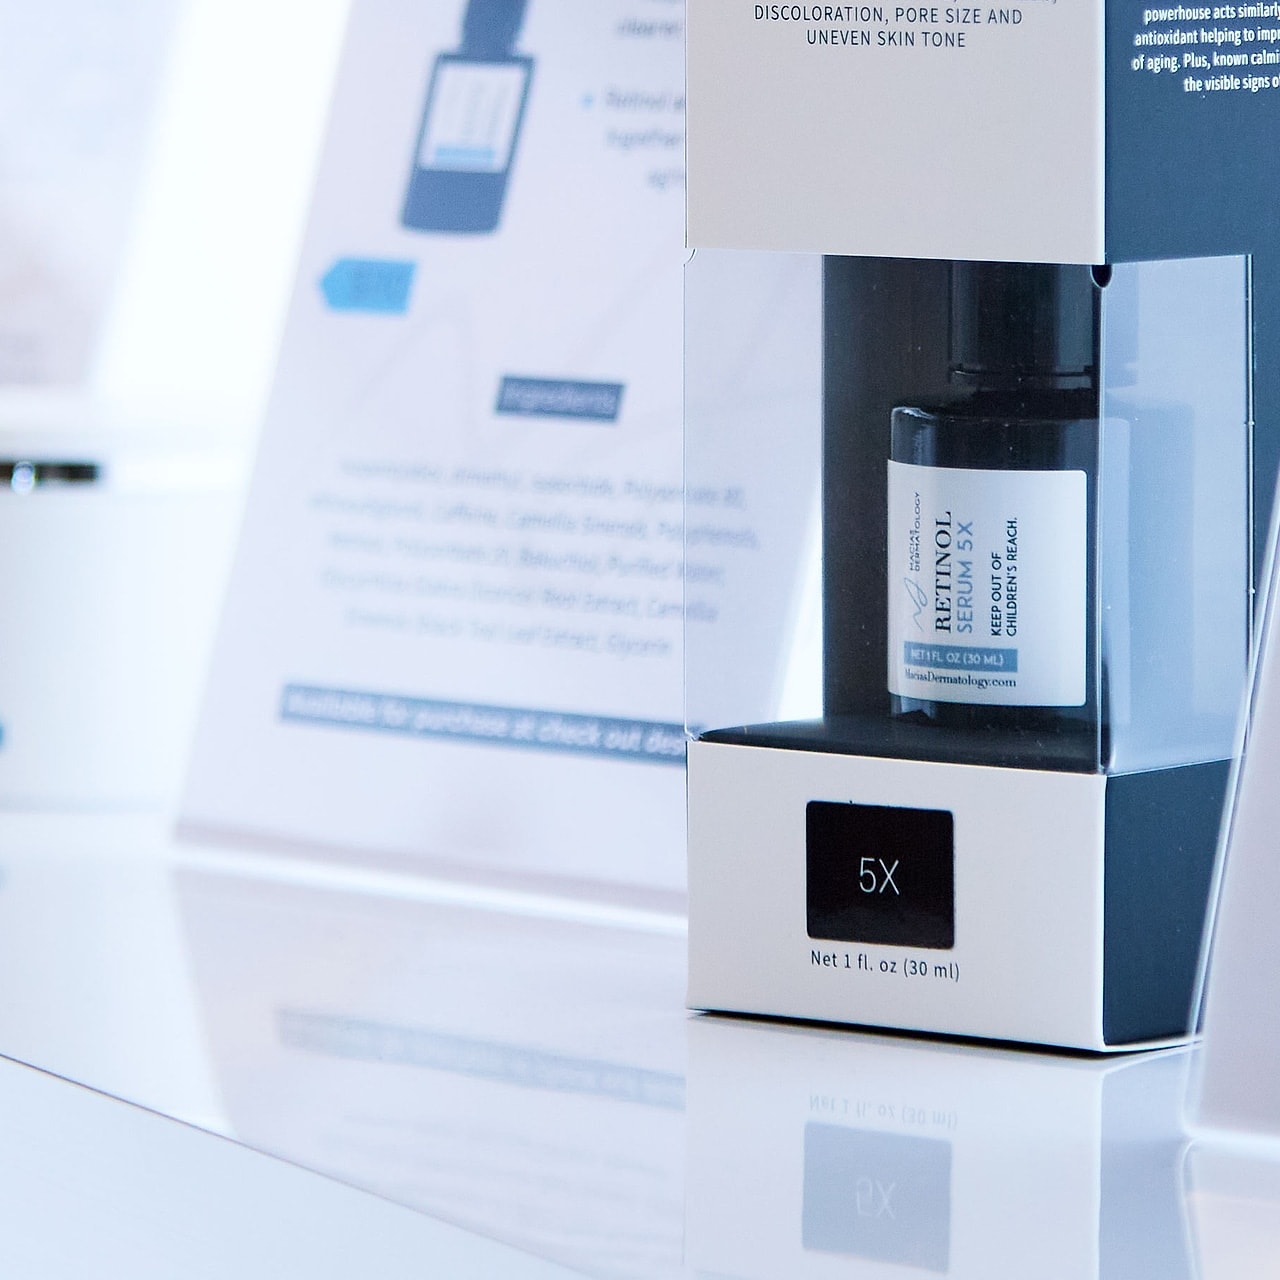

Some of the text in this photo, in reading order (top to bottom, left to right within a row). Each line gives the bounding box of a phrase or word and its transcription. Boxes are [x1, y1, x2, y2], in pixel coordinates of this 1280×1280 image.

[754, 5, 1023, 25] DISCOLORATION, PORE SIZE AND
[1144, 6, 1211, 25] powerhouse
[1213, 5, 1236, 19] acts
[807, 30, 966, 48] UNEVEN SKIN TONE
[1135, 29, 1198, 46] antioxidant
[1201, 28, 1241, 46] helping
[1243, 28, 1255, 42] to
[1133, 54, 1145, 70] of
[1148, 56, 1181, 73] aging.
[1184, 53, 1211, 70] Plus,
[1213, 51, 1248, 66] known
[1184, 77, 1202, 92] the
[1205, 75, 1240, 91] visible
[1242, 74, 1269, 92] signs
[935, 511, 952, 634] RETINOL
[957, 521, 973, 634] SERUM 5X
[1006, 517, 1018, 637] CHILDREN'S REACH.
[991, 552, 1002, 637] KEEP OUT OF
[946, 652, 960, 664] OZ
[963, 653, 980, 665] (30
[984, 654, 1004, 667] ML)
[859, 856, 900, 895] 5X
[811, 950, 960, 982] Net 1 fl. oz (30 ml)
